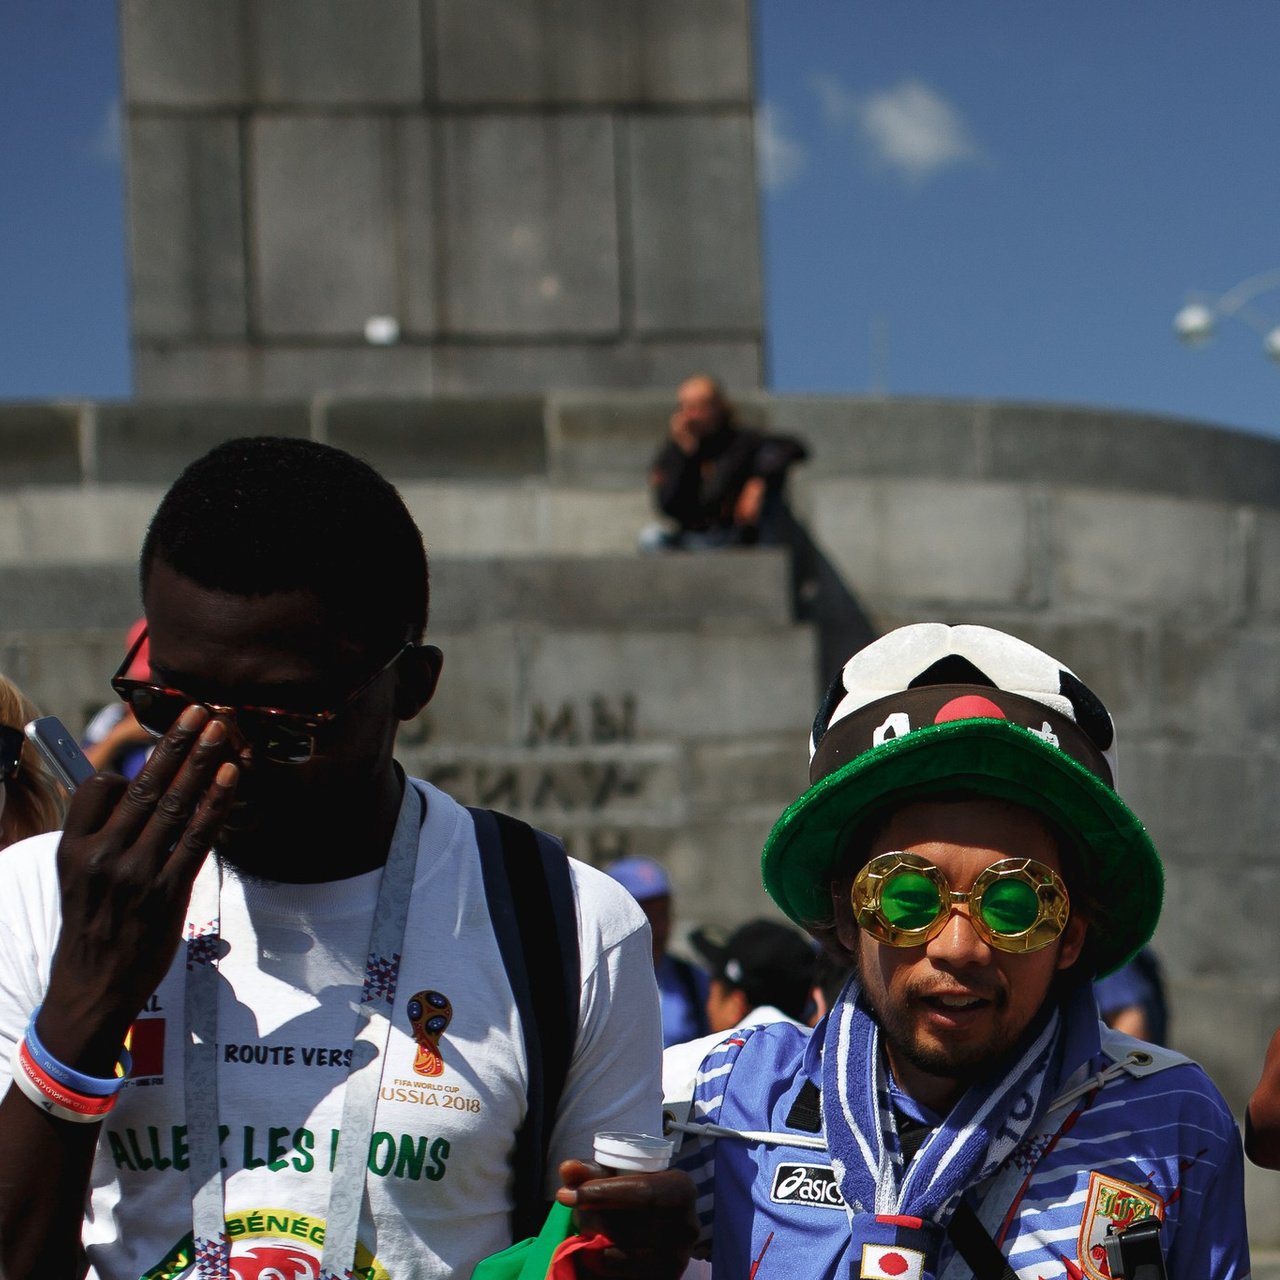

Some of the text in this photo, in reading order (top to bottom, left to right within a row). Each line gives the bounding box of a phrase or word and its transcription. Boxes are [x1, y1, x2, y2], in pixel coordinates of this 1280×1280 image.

[224, 1044, 295, 1065] ROUTE
[302, 1048, 353, 1067] VERS
[394, 1078, 460, 1093] FIFA WORLD CUP
[378, 1086, 481, 1114] USSIA 2018
[243, 1125, 315, 1173] LES
